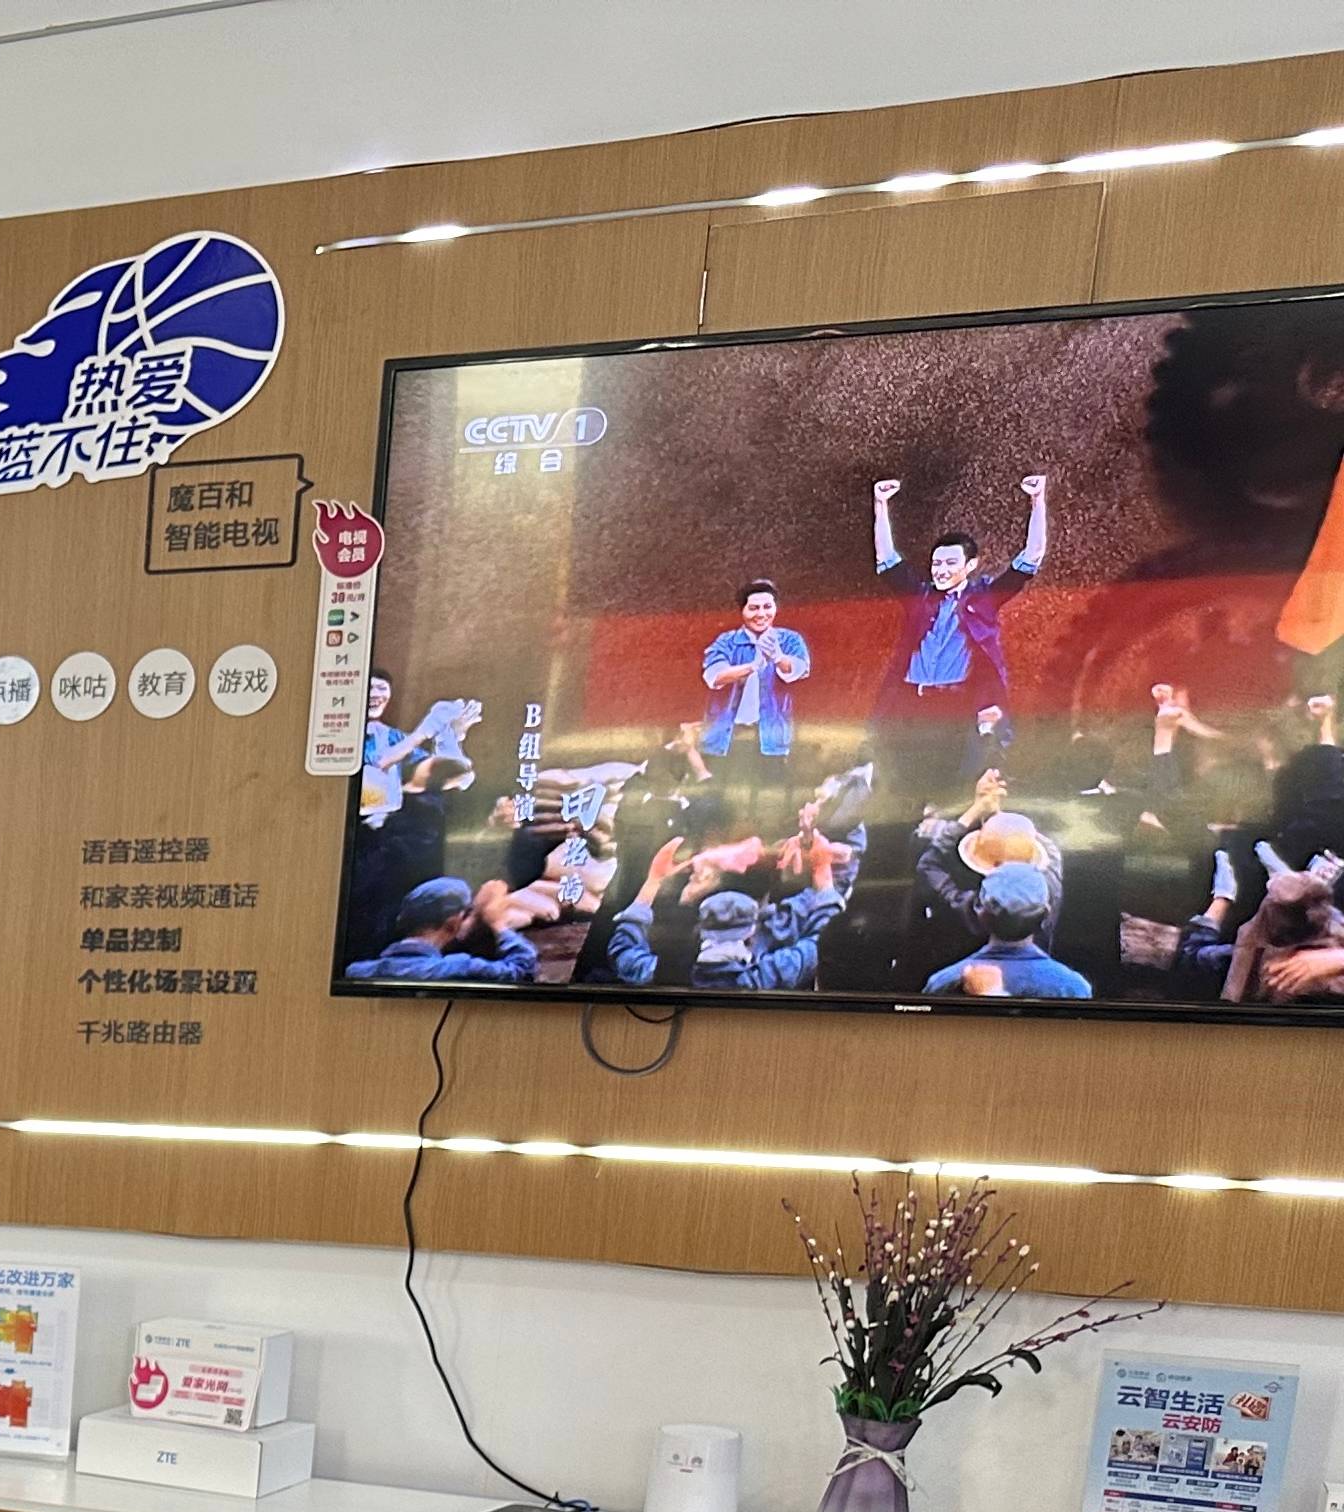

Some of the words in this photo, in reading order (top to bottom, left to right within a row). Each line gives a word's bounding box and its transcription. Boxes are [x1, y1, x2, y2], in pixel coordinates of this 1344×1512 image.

[70, 353, 188, 419] 热爱
[464, 411, 559, 445] CCTV
[575, 413, 588, 441] 1
[494, 449, 563, 476] 综合
[166, 480, 254, 514] 魔百和
[164, 516, 280, 553] 智能电视
[337, 546, 366, 563] 会员
[57, 673, 109, 699] 咪咕
[137, 671, 189, 699] 教育
[216, 667, 270, 695] 游戏
[81, 838, 210, 866] 语音遥控器
[79, 884, 259, 911] 和家亲视频通话
[79, 926, 182, 953] 单品控制
[78, 968, 259, 996] 个性化场景设置
[77, 1020, 203, 1047] 千兆路由器
[175, 1337, 191, 1348] ZTE
[1116, 1384, 1225, 1416] 云智生活
[1162, 1412, 1223, 1434] 云安防
[156, 1450, 178, 1465] ZTE
